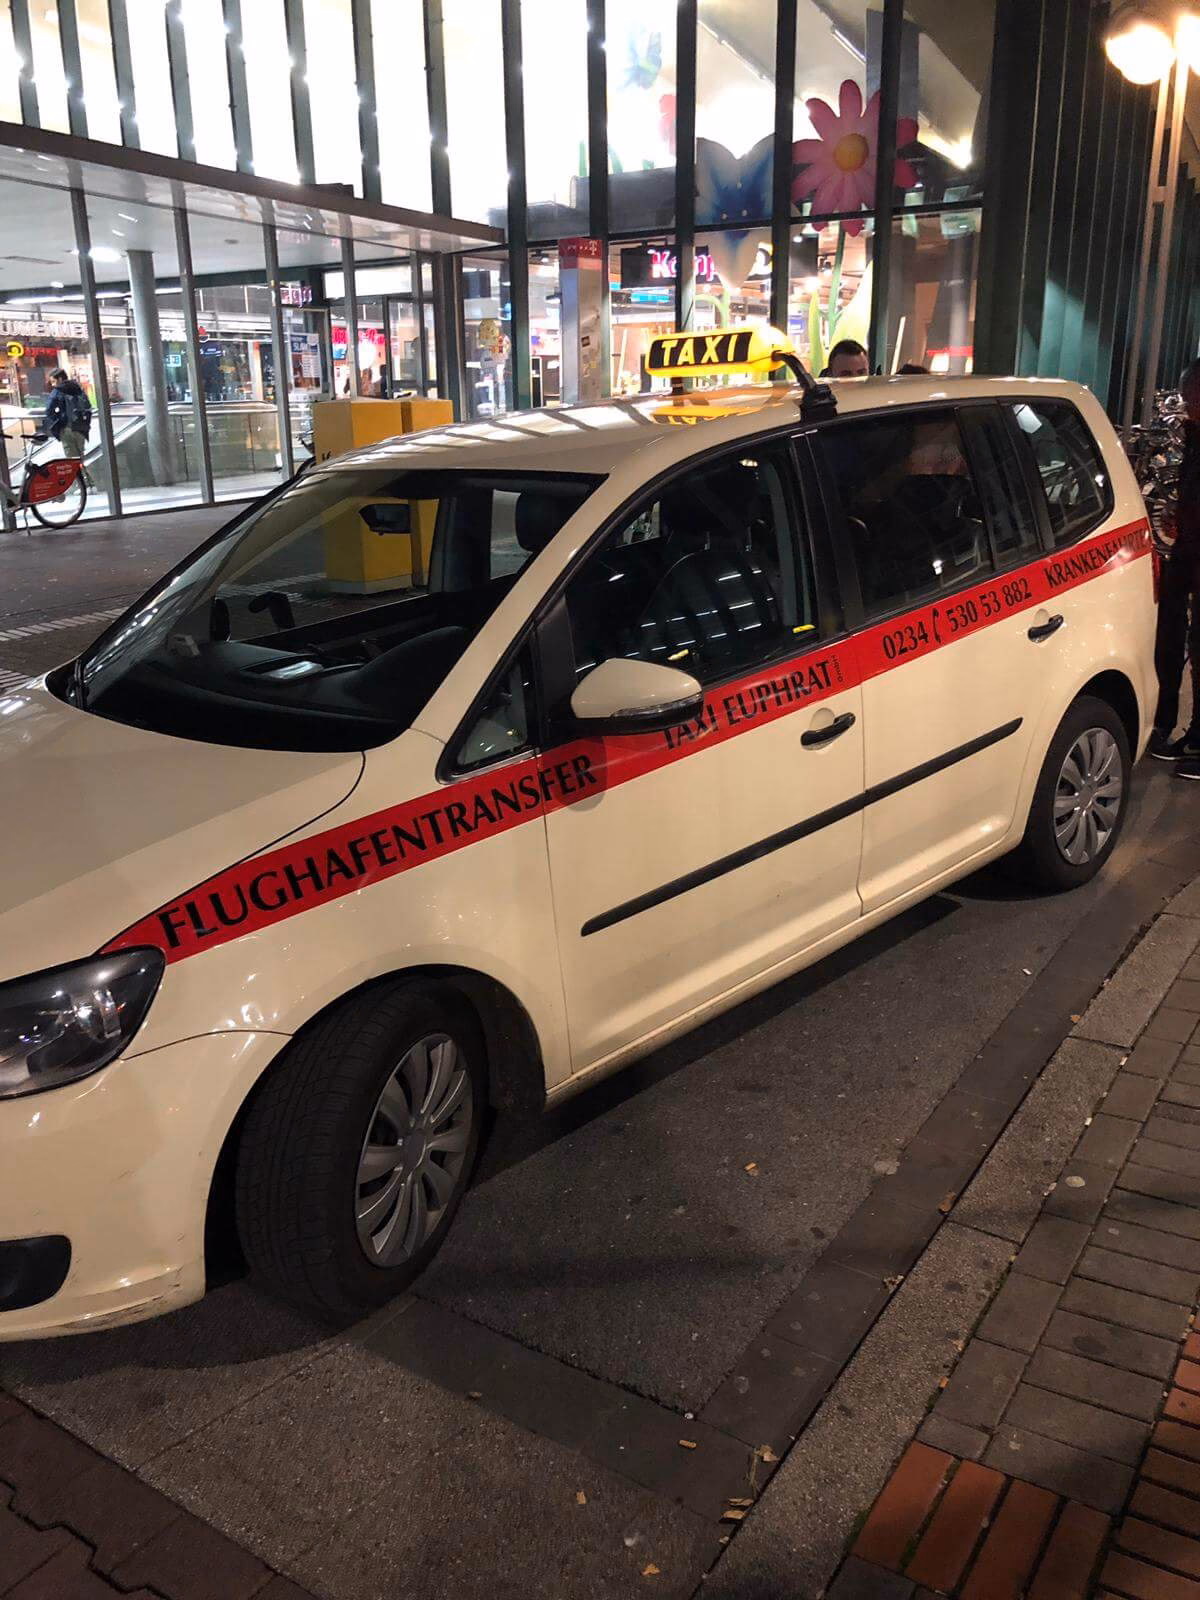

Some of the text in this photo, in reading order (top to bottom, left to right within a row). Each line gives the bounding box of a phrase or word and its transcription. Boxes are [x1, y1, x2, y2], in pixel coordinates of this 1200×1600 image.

[661, 334, 739, 367] TAXI
[882, 577, 1033, 659] 0234 530 53 882
[663, 660, 833, 749] TAXI EUPHRAT
[157, 752, 598, 948] FLUGHAFENTRANSFER
